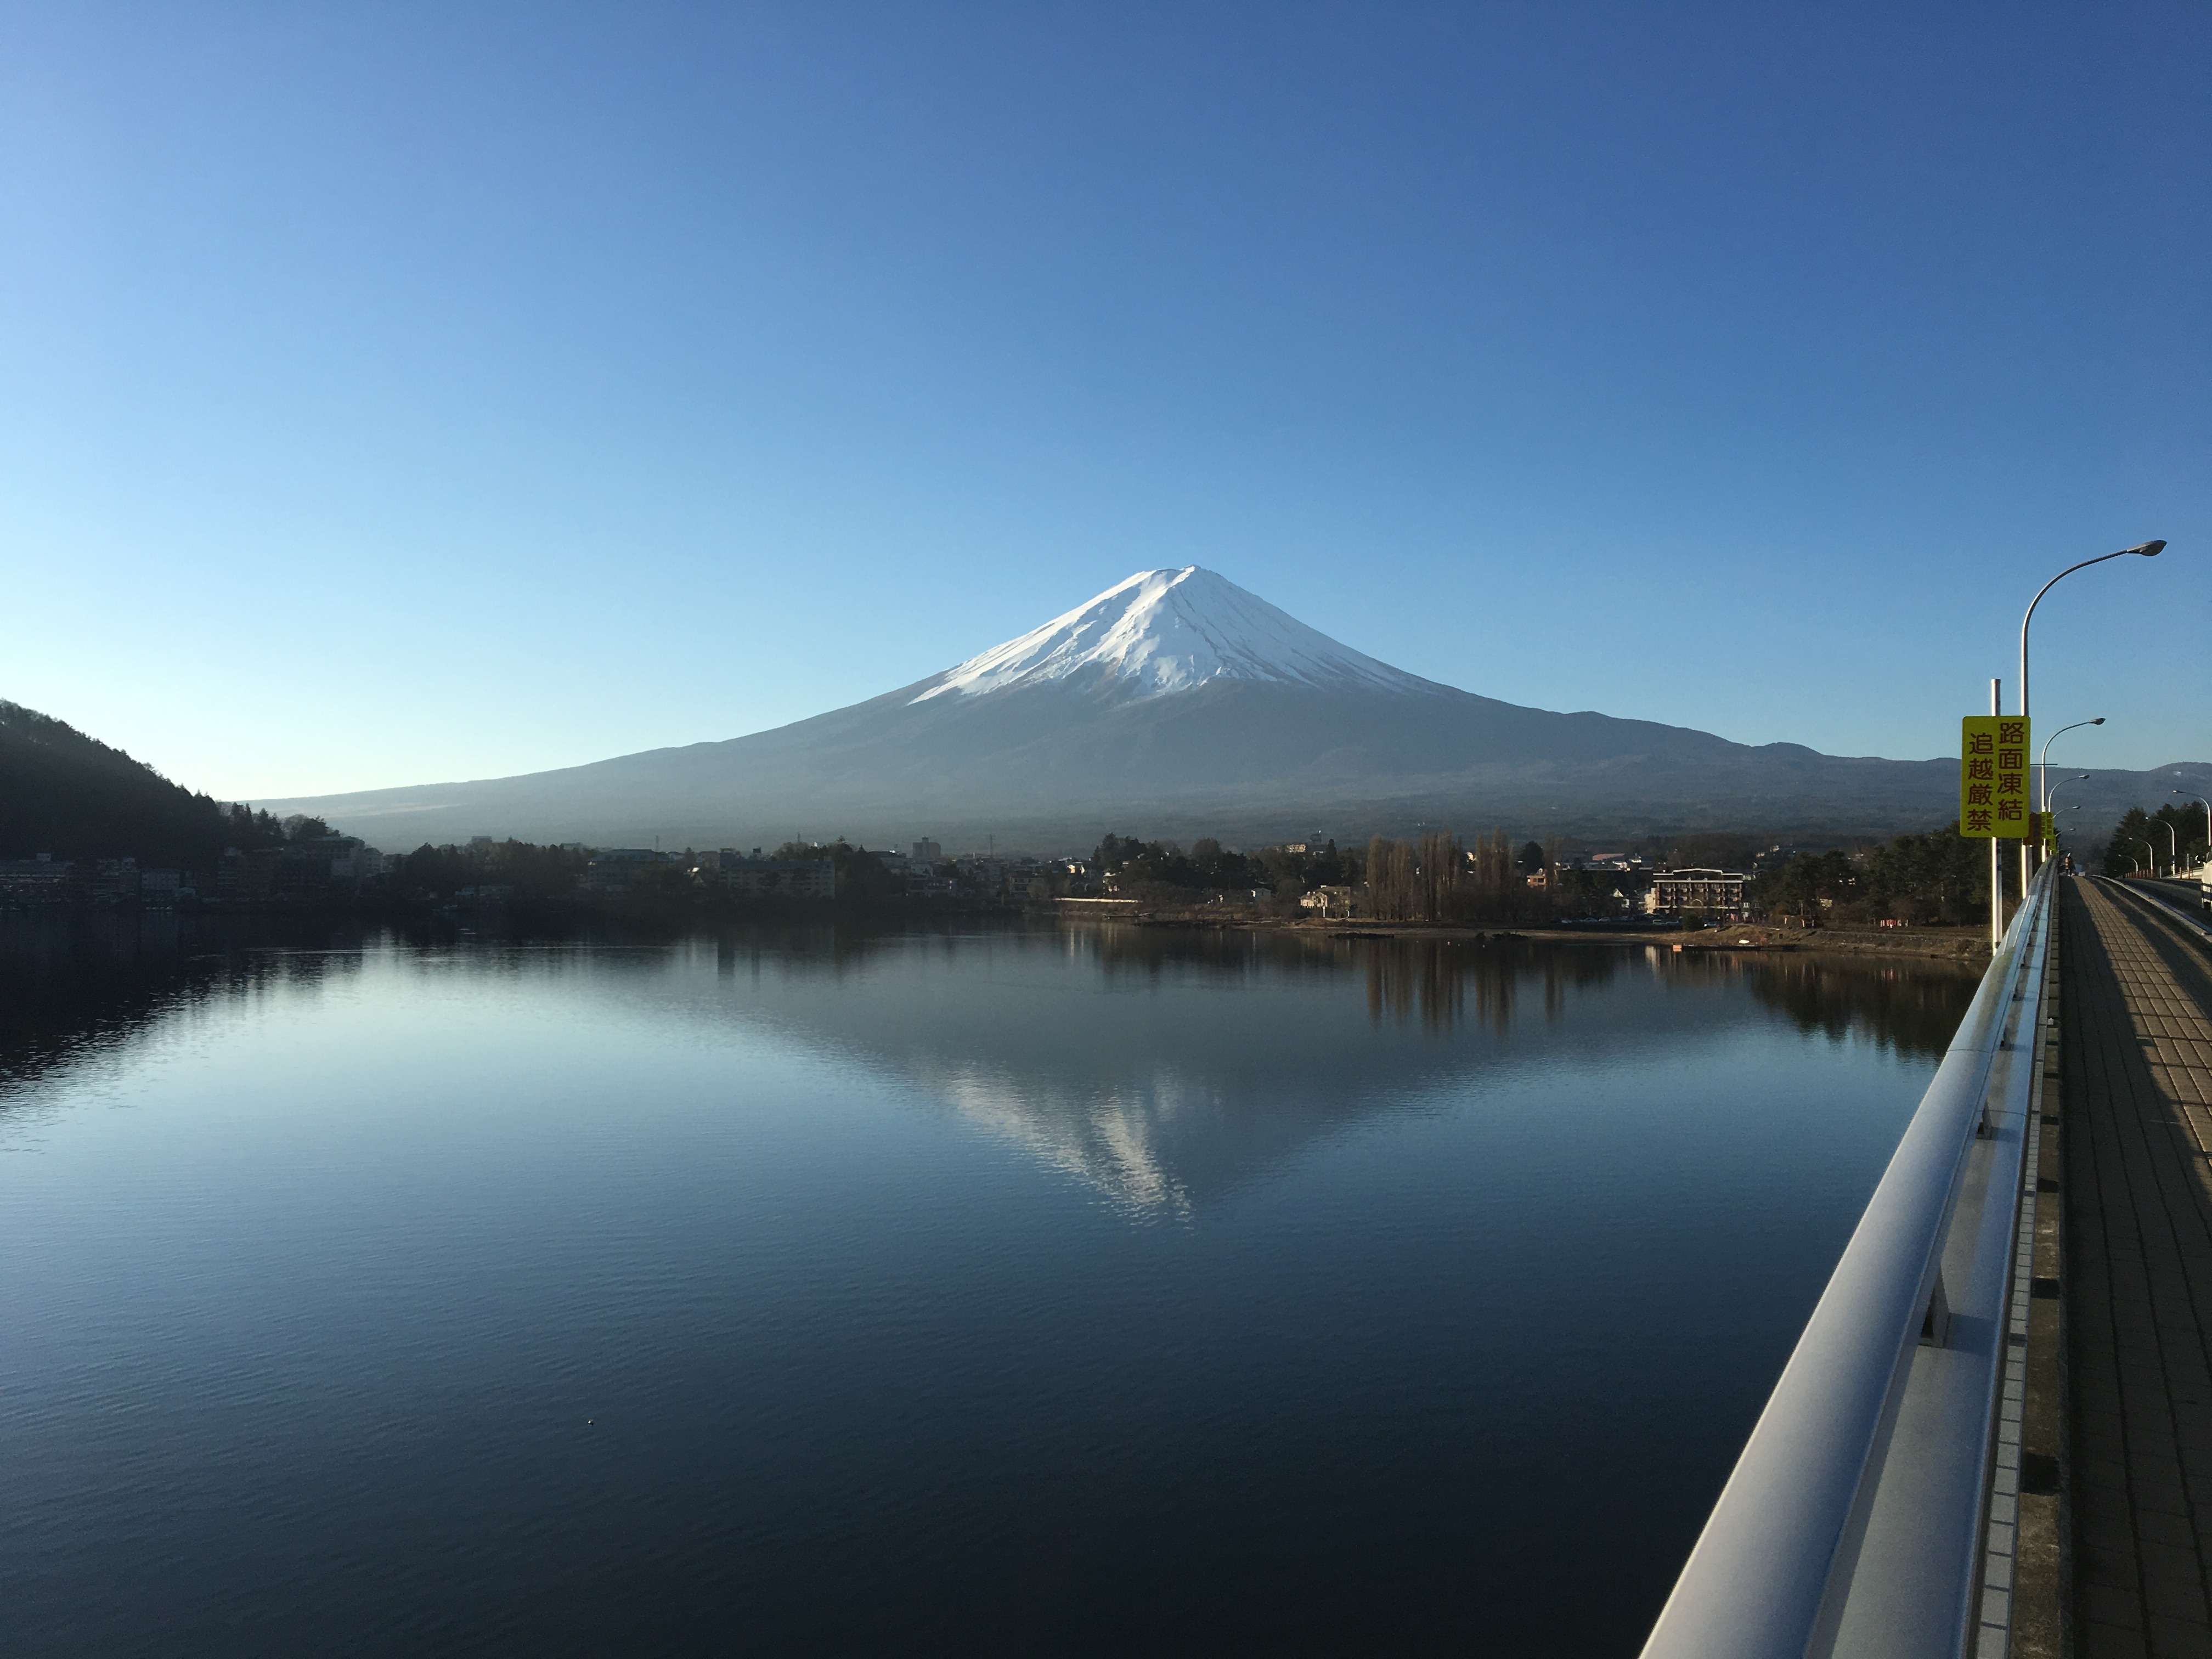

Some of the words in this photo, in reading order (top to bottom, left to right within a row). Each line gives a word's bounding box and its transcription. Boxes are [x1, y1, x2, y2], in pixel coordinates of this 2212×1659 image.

[1967, 732, 1994, 832] 追越厳禁
[1997, 722, 2024, 821] 路面凍結
